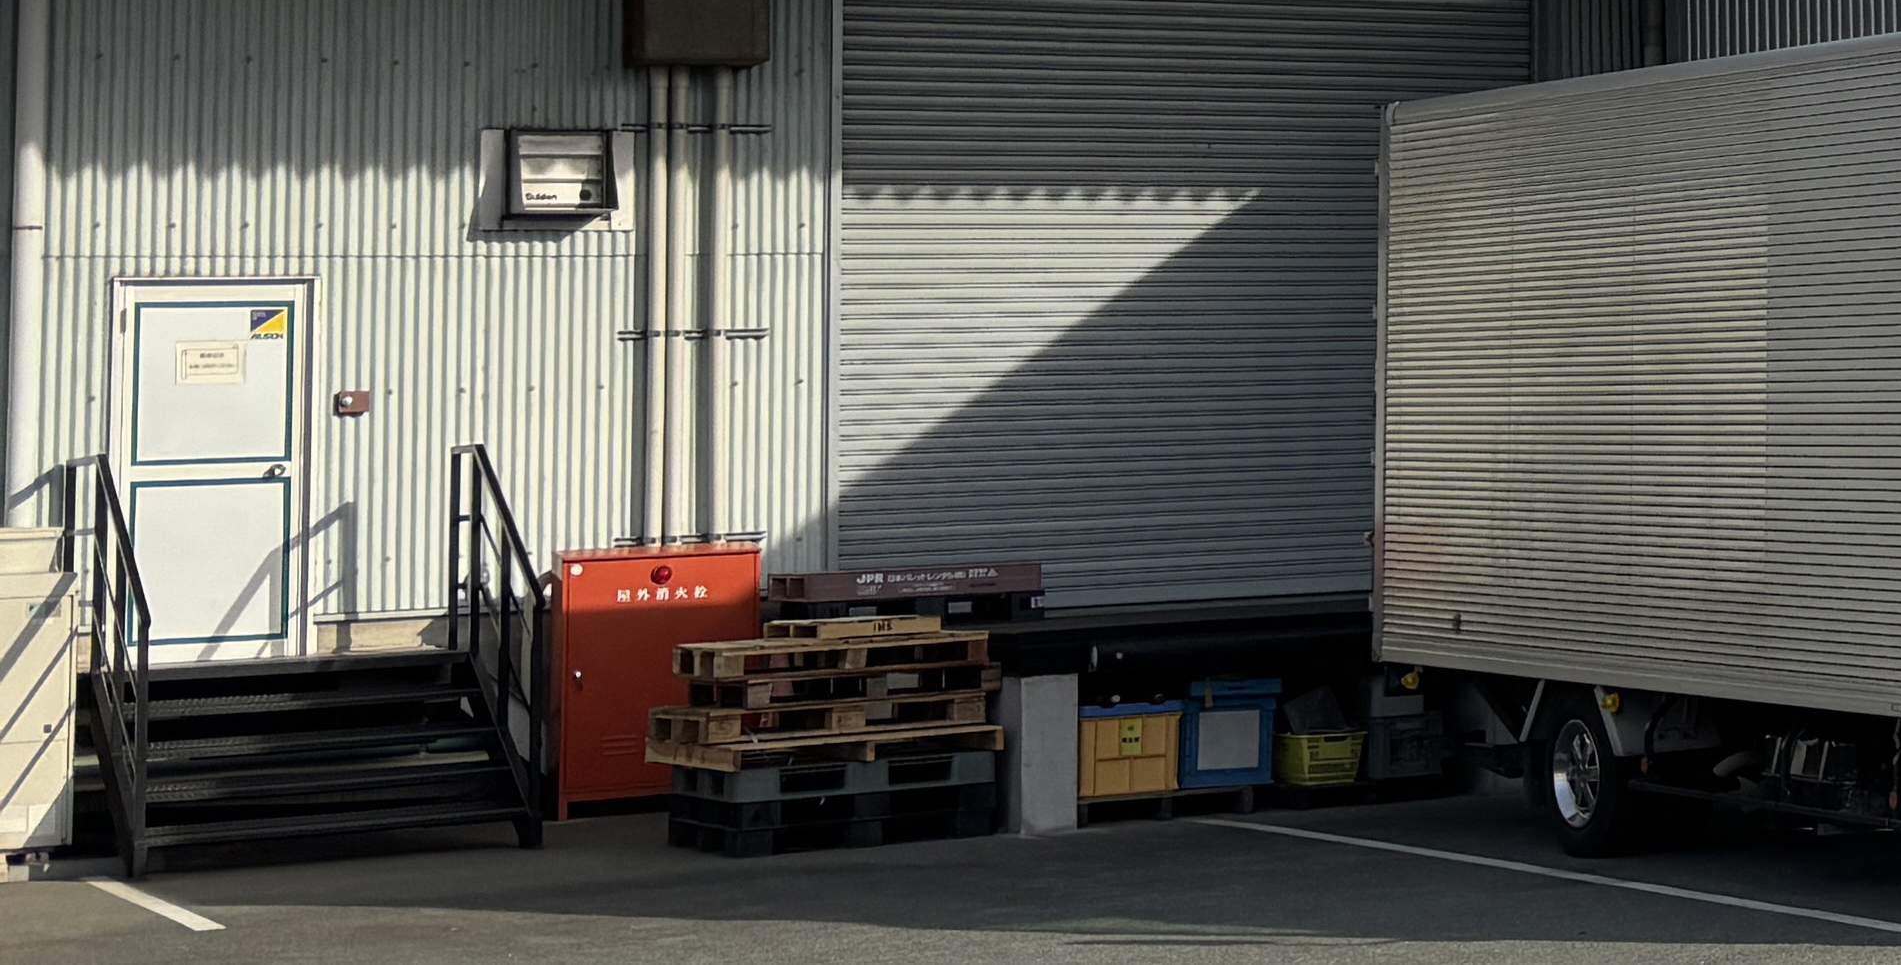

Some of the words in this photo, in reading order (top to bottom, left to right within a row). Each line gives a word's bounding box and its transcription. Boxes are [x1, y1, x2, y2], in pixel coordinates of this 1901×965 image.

[856, 573, 884, 584] JPR
[617, 585, 708, 602] 屋外消火栓
